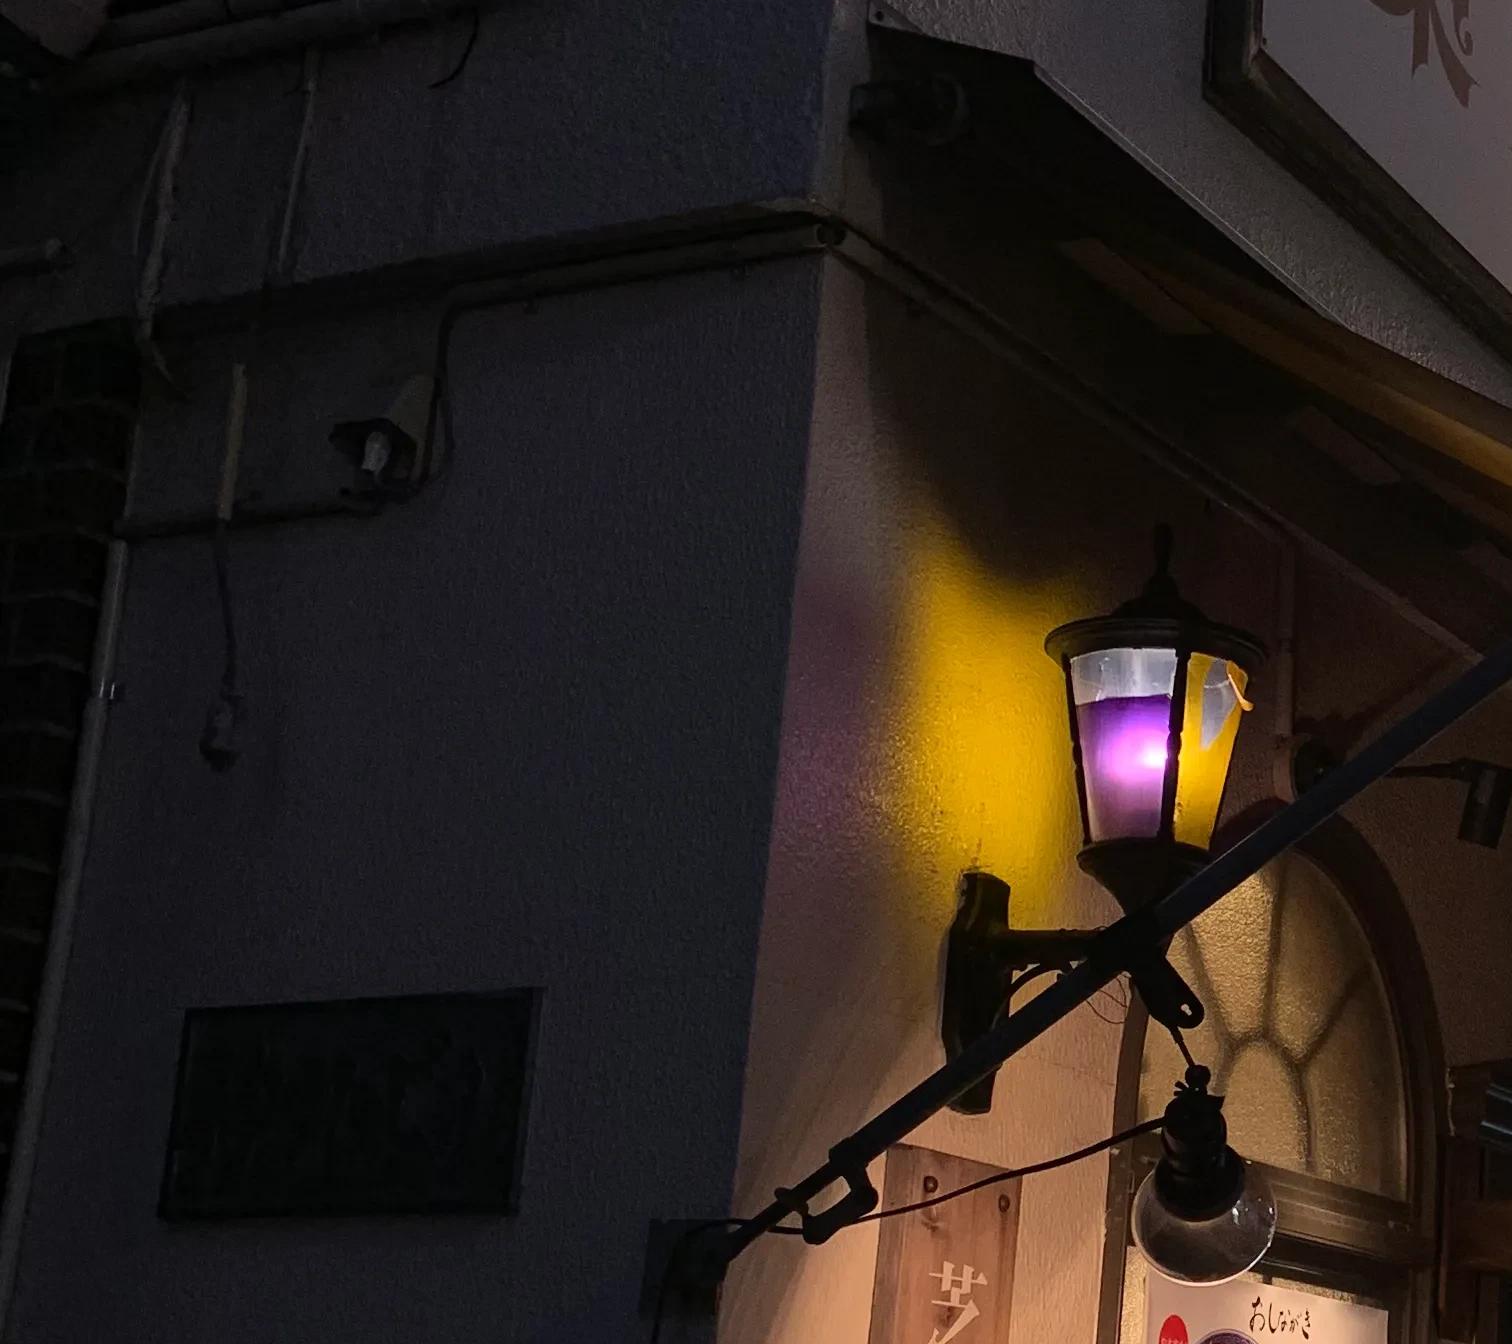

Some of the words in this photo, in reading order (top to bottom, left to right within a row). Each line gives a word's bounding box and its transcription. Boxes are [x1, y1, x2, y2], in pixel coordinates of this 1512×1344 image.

[1249, 1295, 1311, 1340] おしながき
